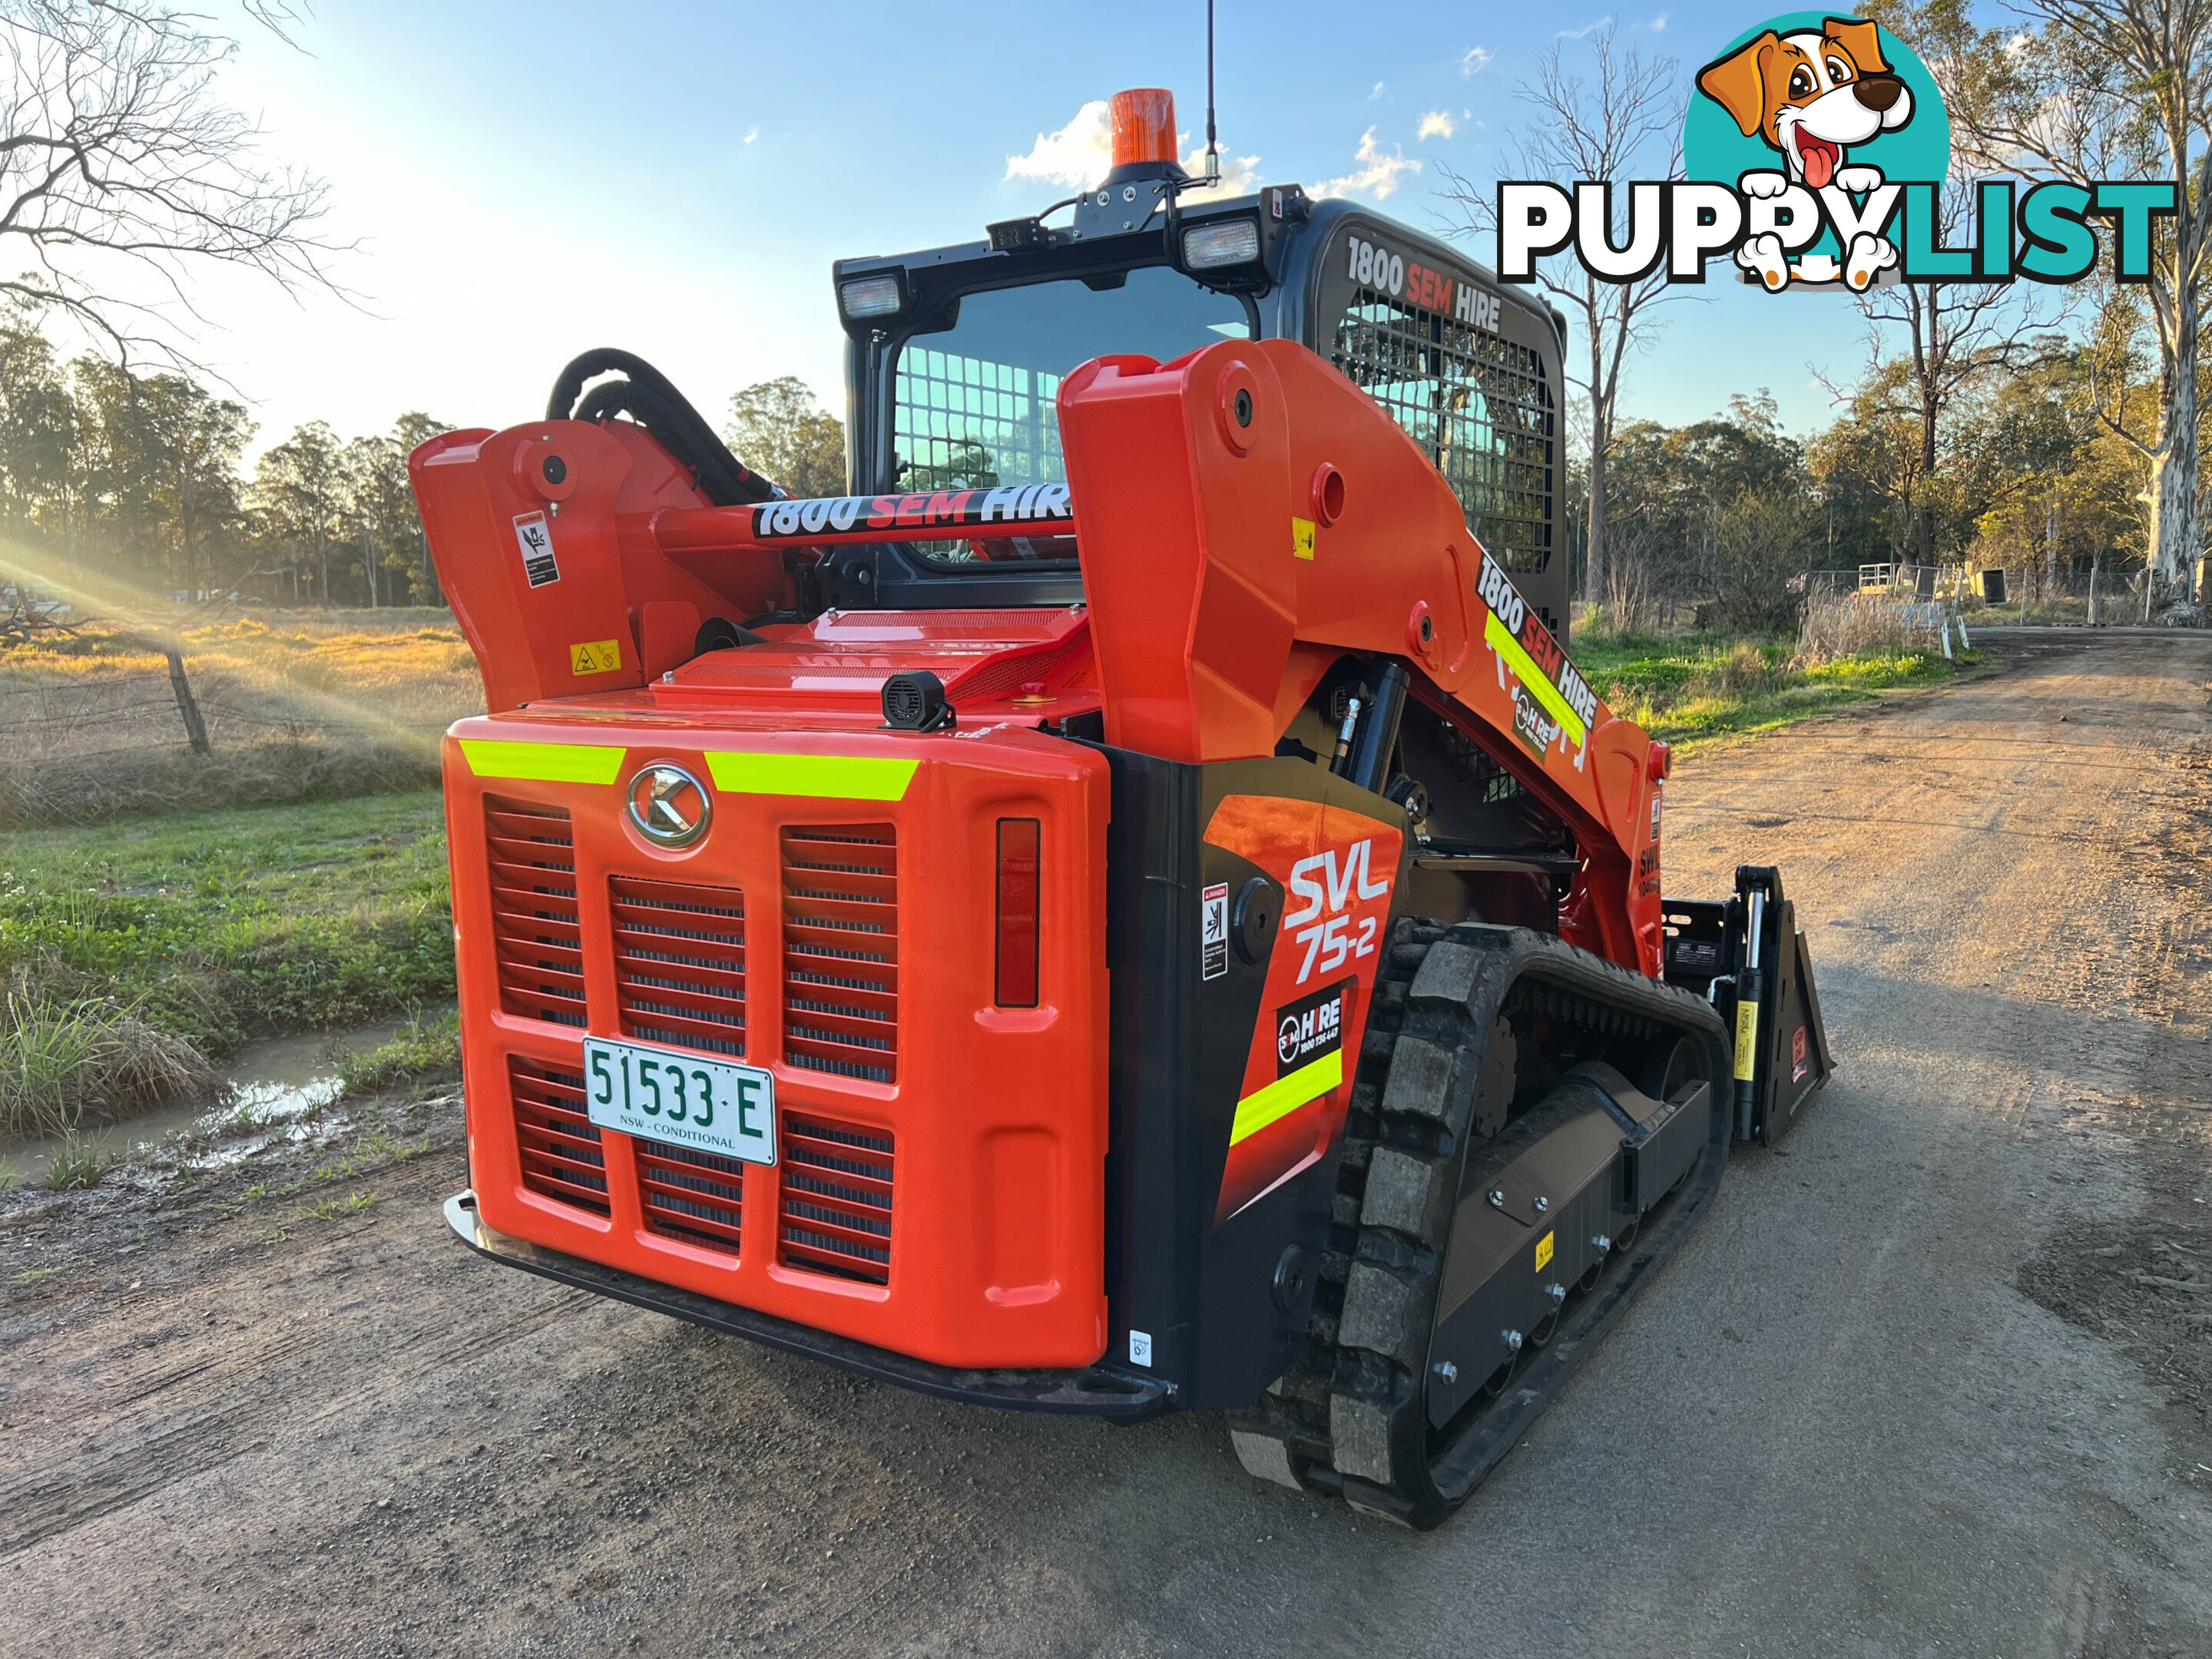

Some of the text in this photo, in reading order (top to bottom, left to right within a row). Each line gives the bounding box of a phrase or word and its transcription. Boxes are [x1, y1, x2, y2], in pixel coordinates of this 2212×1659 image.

[1349, 237, 1501, 333] 1800 SEM HIRE
[757, 483, 1073, 535] 1800 SEM HIR
[1477, 555, 1524, 634] 1800
[1522, 614, 1561, 683] SEM
[1558, 660, 1598, 729] HIRE
[1527, 707, 1550, 745] HIRE
[1284, 839, 1388, 930] SVL
[1296, 914, 1376, 985] 75-2
[1301, 998, 1341, 1041] HIRE
[620, 1115, 644, 1128] NSW
[654, 1123, 736, 1149] CONDITIONAL
